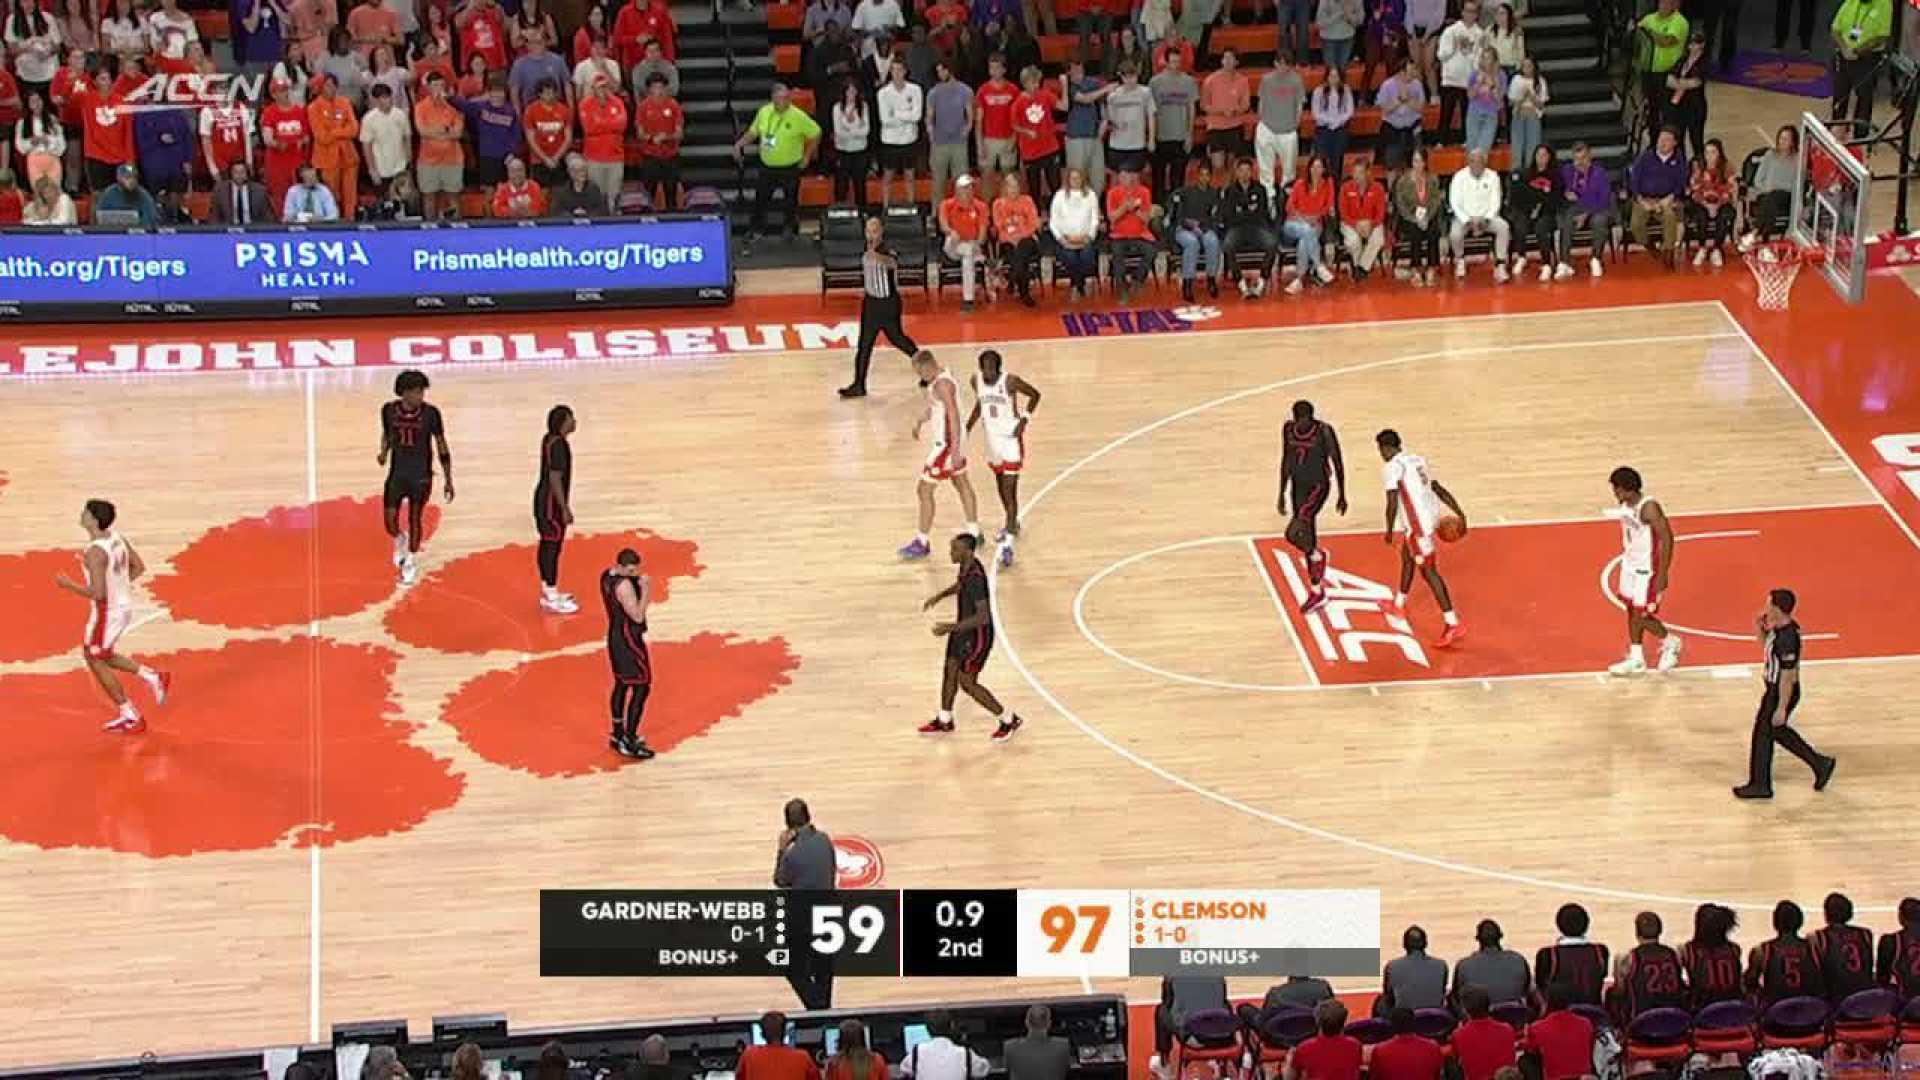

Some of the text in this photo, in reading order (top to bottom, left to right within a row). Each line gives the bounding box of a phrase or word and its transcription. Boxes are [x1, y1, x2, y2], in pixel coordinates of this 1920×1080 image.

[235, 241, 370, 268] PRISMA
[413, 243, 702, 271] PrismaHealth.org/Tigers
[0, 321, 861, 373] EJOHN COLISEUM
